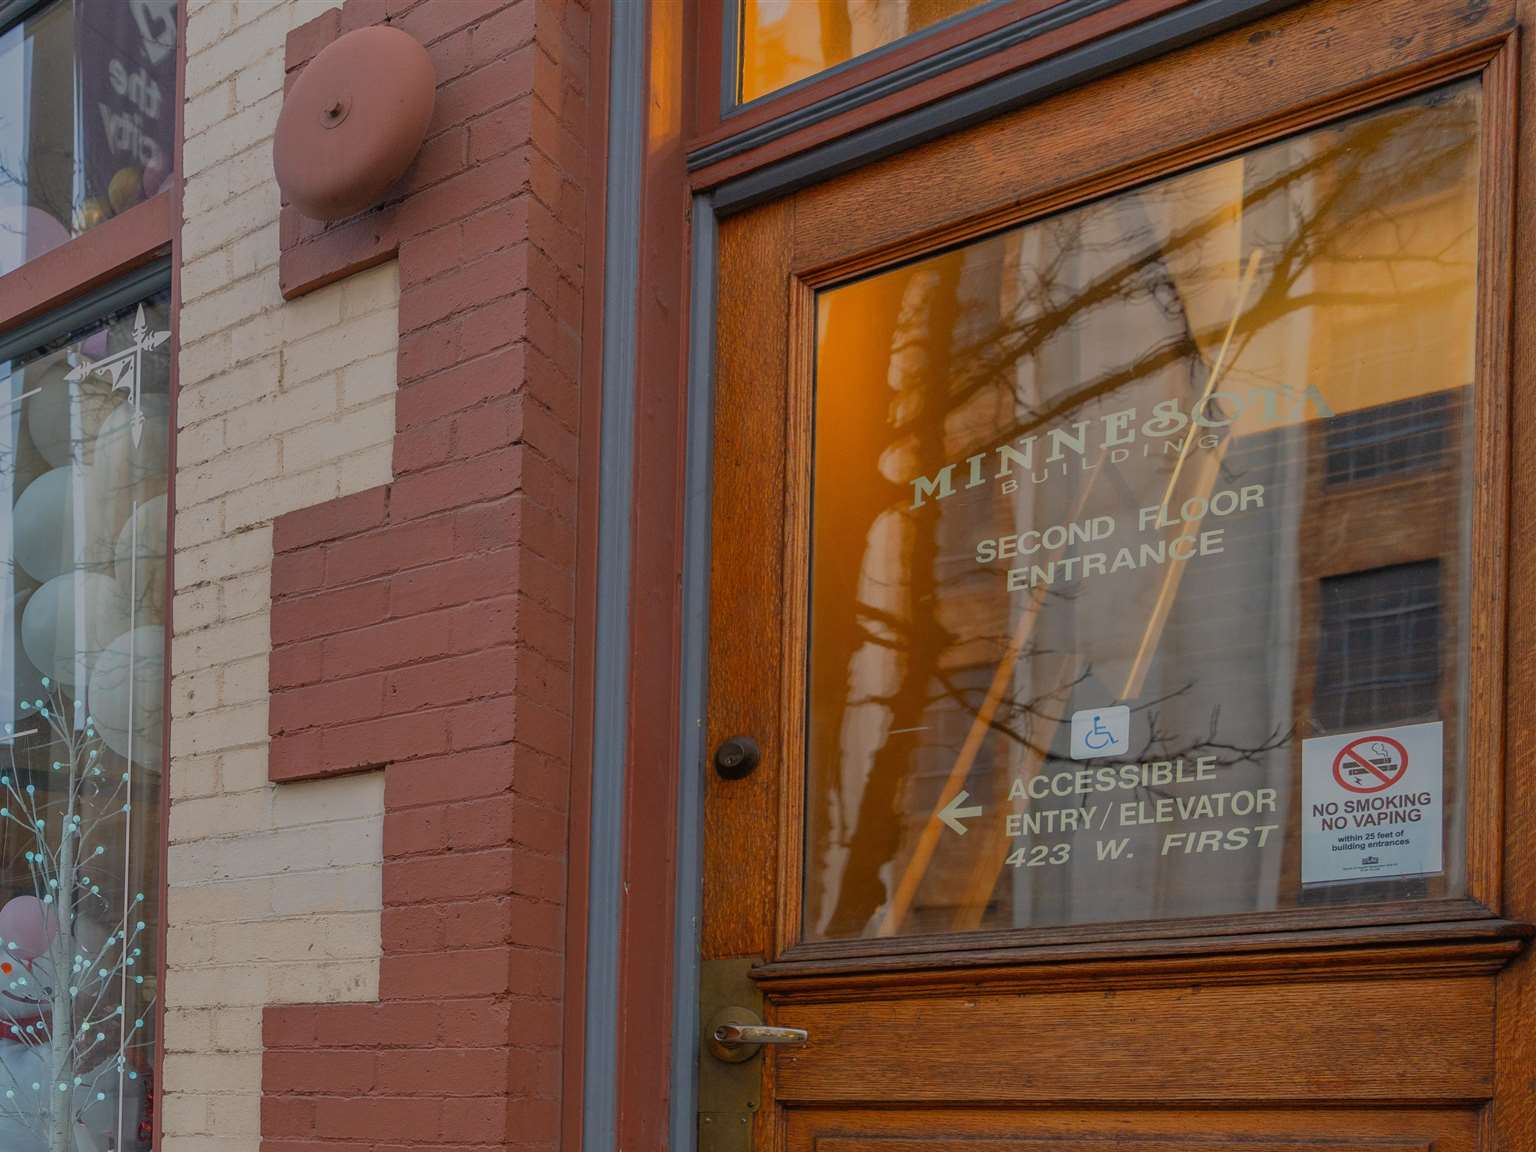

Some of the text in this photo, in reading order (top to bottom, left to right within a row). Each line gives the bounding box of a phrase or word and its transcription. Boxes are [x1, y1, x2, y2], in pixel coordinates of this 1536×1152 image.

[909, 384, 1335, 511] MINNESOTA
[1001, 434, 1220, 495] BUILDING
[976, 484, 1265, 563] SECOND FLOOR
[1007, 529, 1225, 592] ENTRANCE
[1008, 756, 1217, 800] ACCESSIBLE
[1312, 792, 1431, 817] NO SMOKING
[1321, 809, 1422, 831] NO VAPING
[1005, 825, 1279, 867] 423 W. FIRST
[1332, 838, 1409, 851] building entrances
[1338, 835, 1363, 843] within
